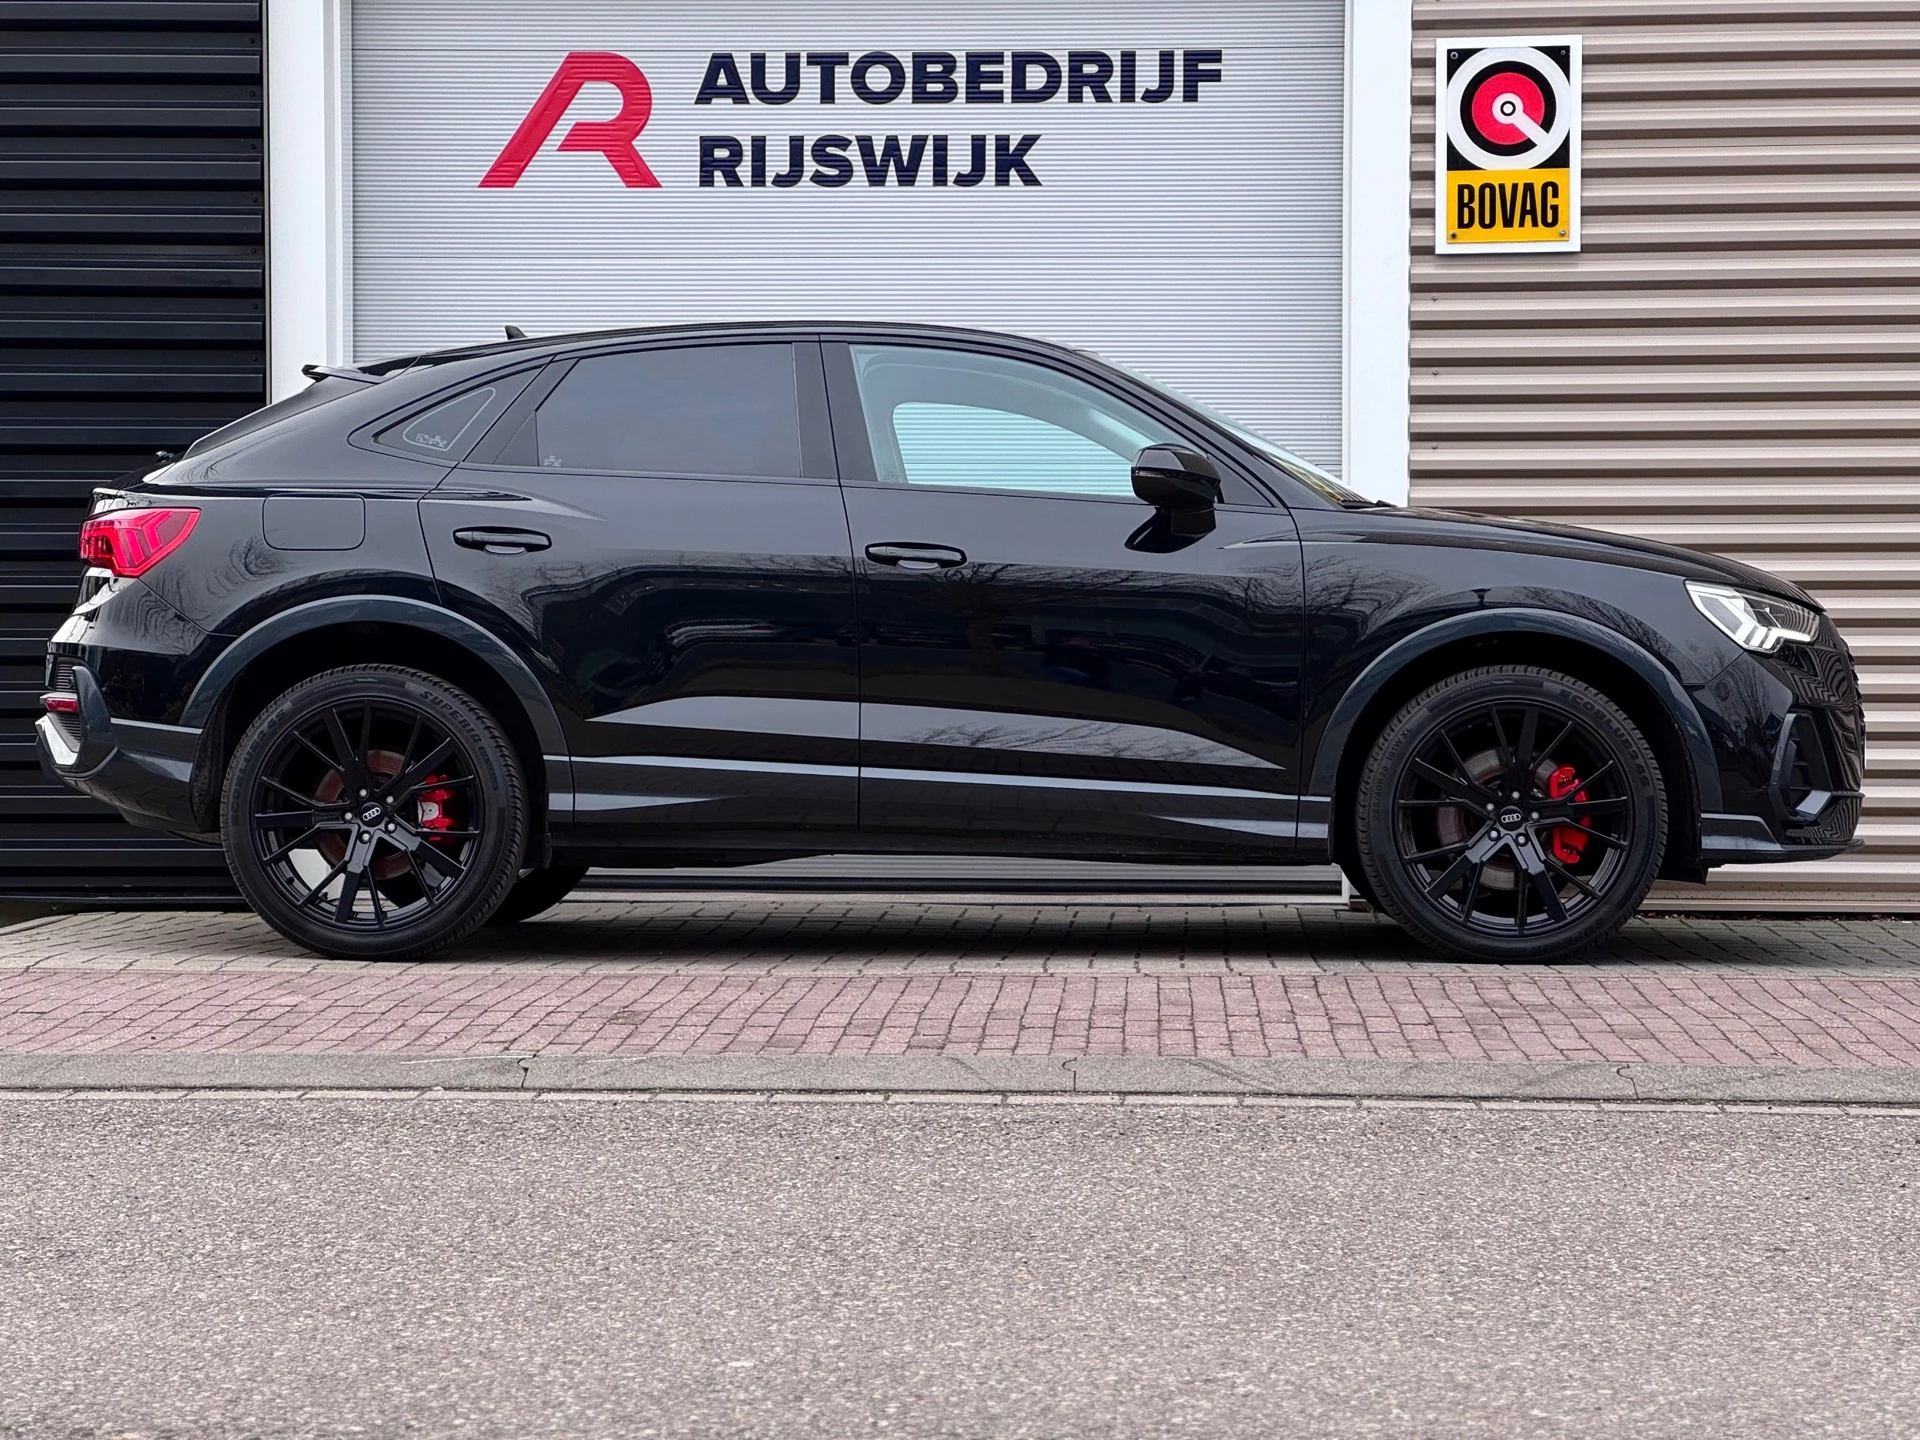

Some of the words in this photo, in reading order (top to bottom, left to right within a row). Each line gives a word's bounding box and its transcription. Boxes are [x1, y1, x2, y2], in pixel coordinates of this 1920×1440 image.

[694, 49, 1223, 105] AUTOBEDRIJF
[699, 133, 1043, 188] RIJSWIJK
[1457, 181, 1560, 230] BOVAG
[419, 690, 483, 744] SUPERIA
[1386, 738, 1403, 762] 101W
[1401, 726, 1413, 739] XL
